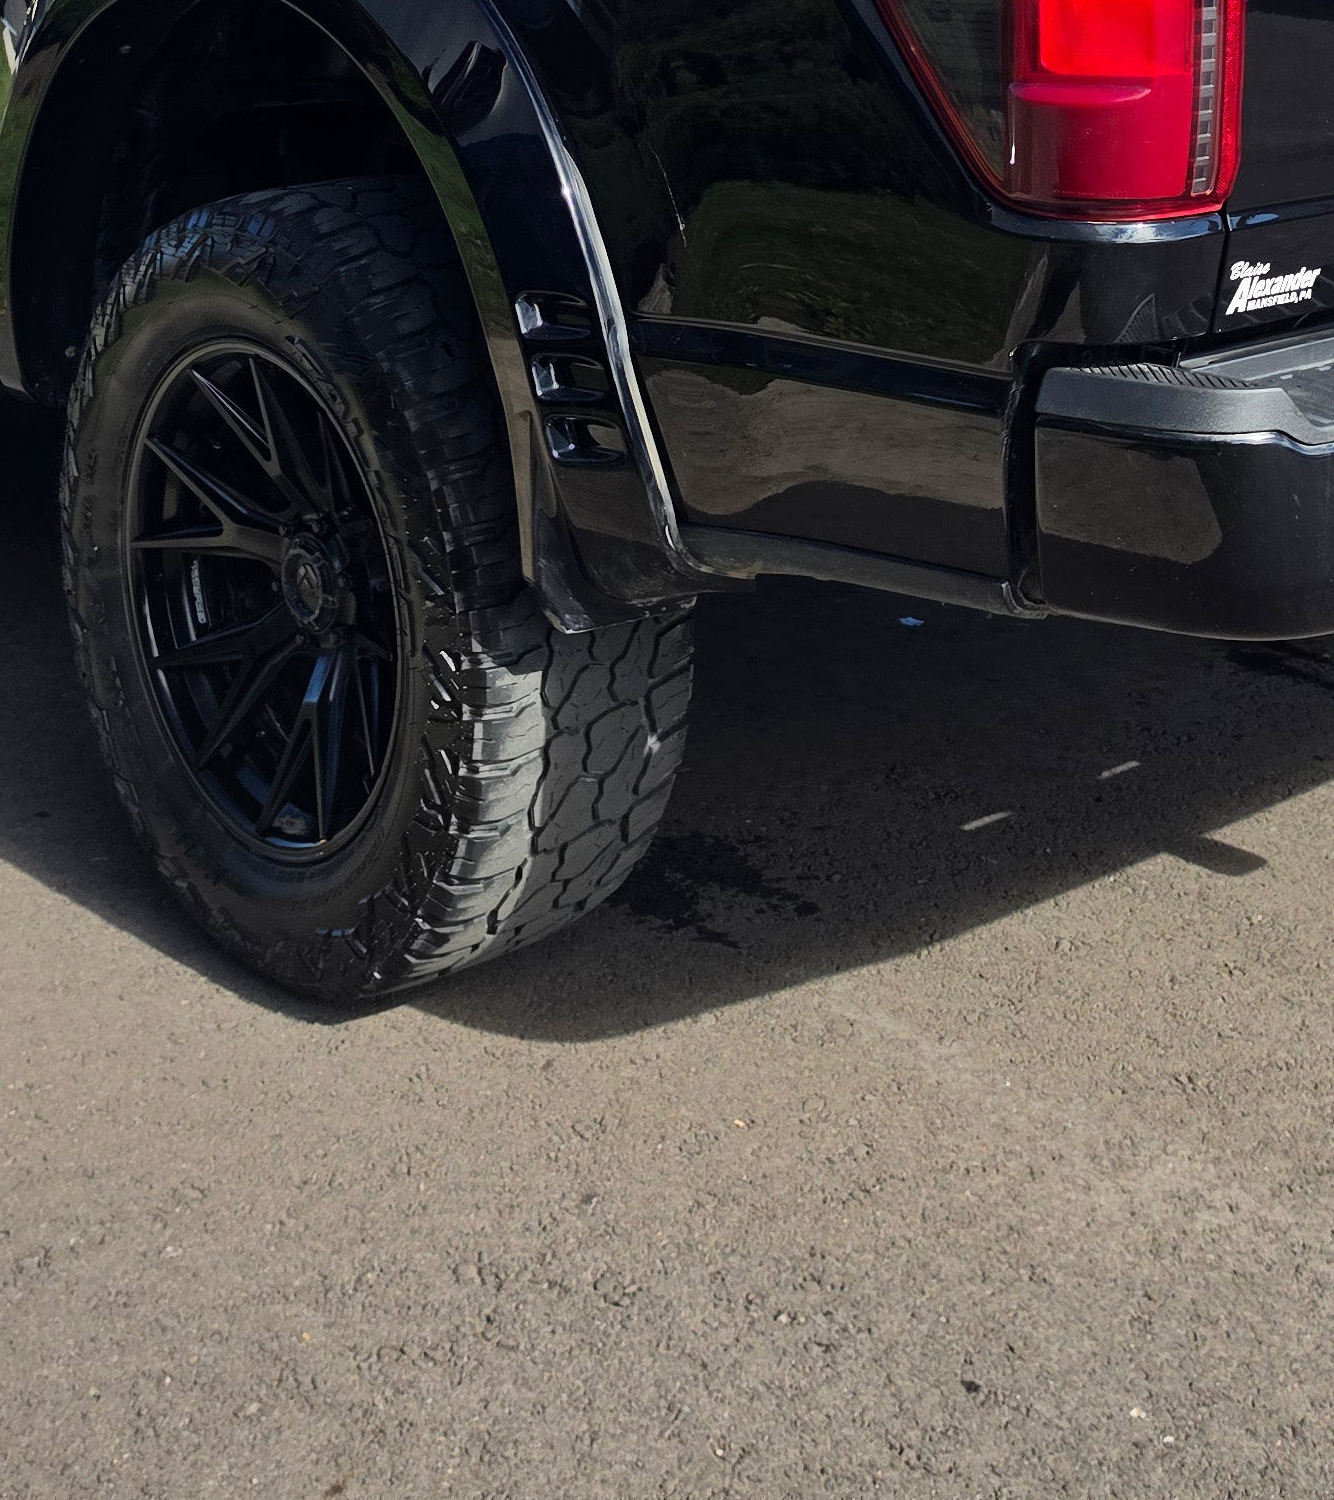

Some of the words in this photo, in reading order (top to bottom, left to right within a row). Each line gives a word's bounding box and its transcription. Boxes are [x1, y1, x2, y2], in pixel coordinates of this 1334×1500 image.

[1229, 261, 1270, 280] Blaise
[1225, 267, 1322, 315] Alexander
[1298, 288, 1312, 301] PA
